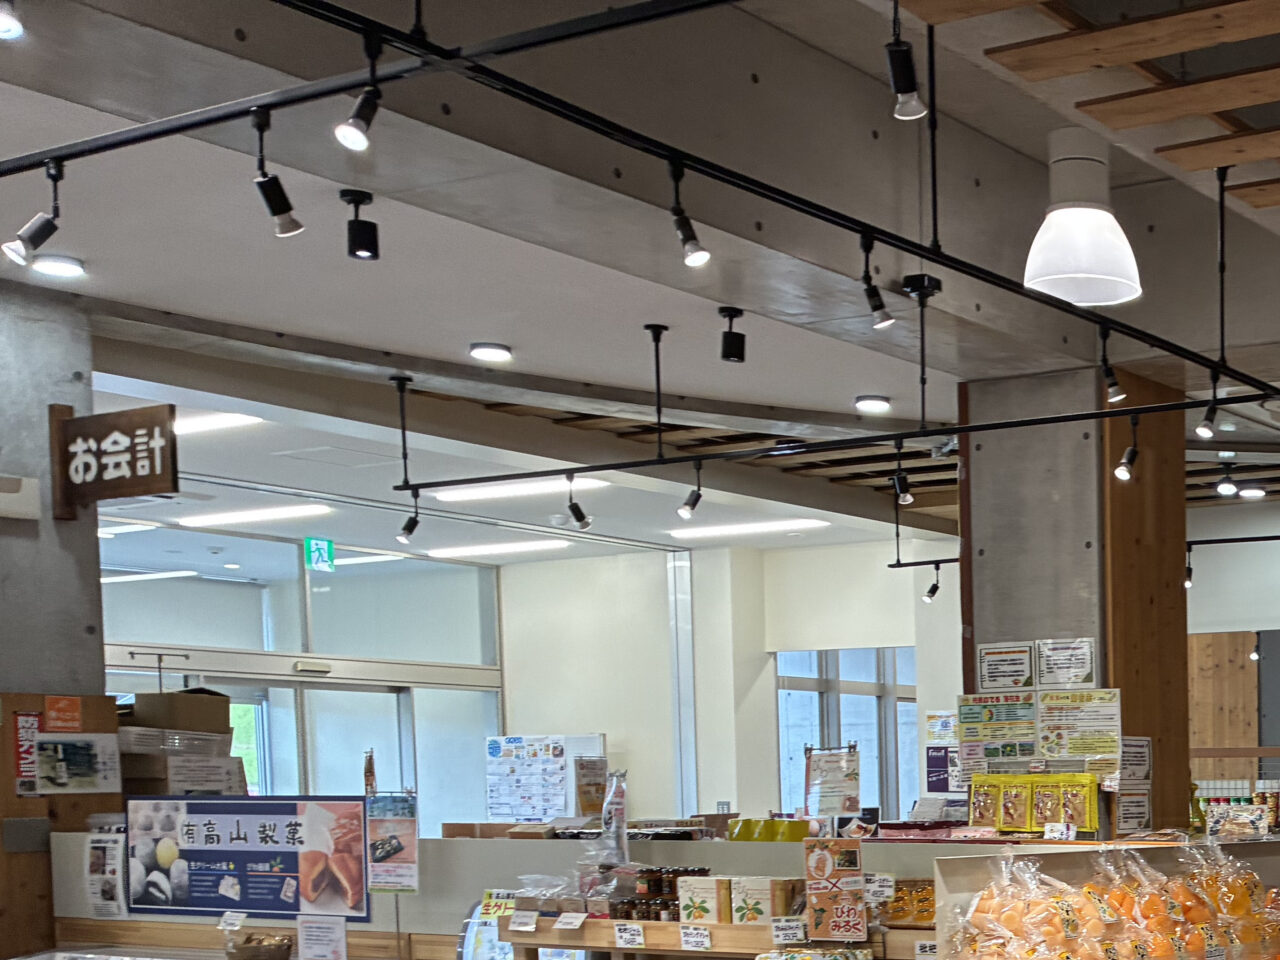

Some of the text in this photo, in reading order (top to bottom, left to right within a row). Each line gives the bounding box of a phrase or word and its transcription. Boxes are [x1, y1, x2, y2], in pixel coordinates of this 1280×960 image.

[68, 426, 166, 484] お会計
[834, 905, 859, 919] びわ
[830, 918, 864, 934] みるく
